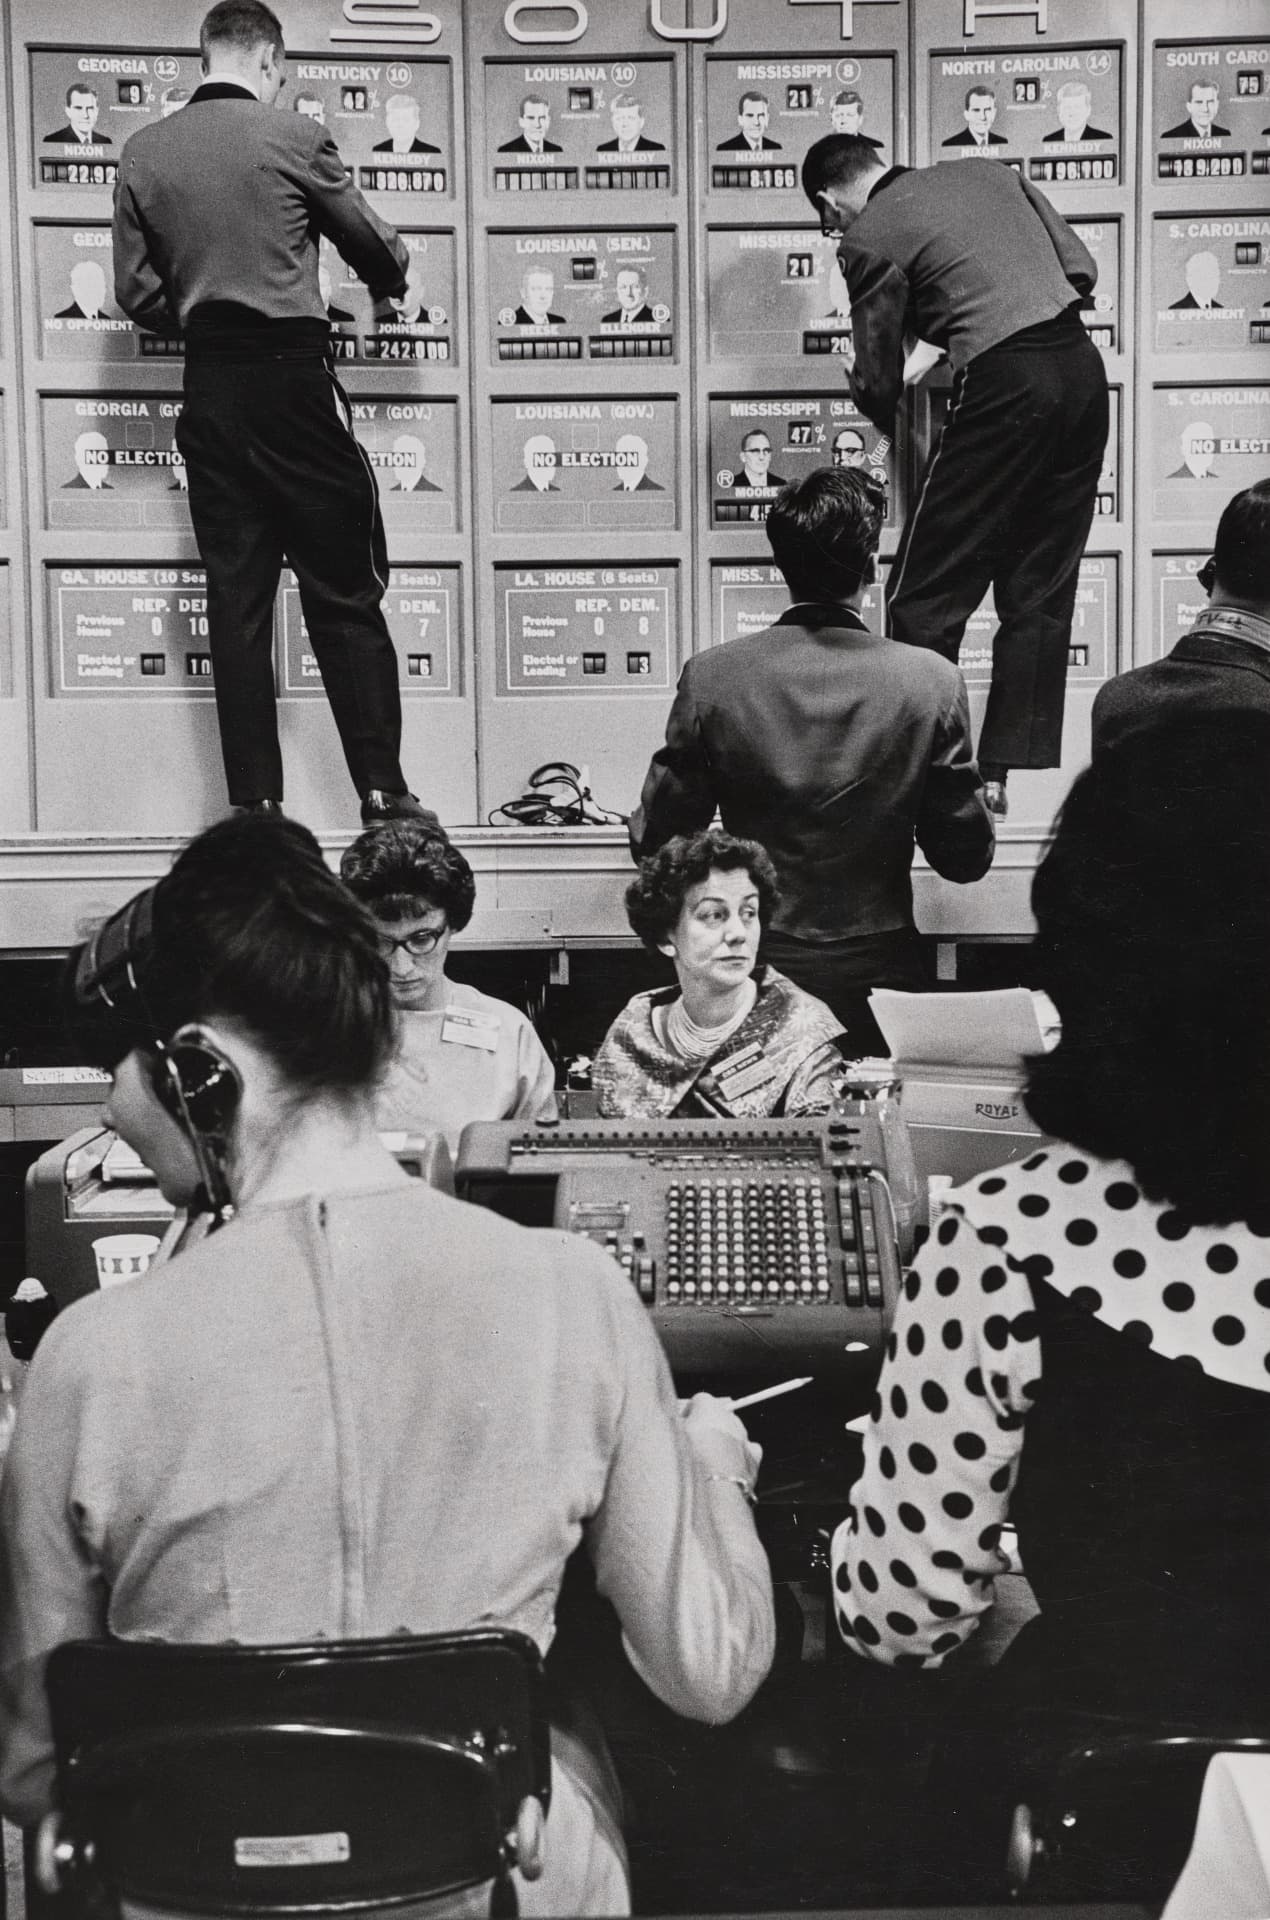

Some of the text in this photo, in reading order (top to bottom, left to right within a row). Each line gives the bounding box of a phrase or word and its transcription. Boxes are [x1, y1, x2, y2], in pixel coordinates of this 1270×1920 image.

[78, 58, 177, 75] GEORGIA 12
[942, 55, 1109, 76] NORTH CAROLINA 14
[1166, 51, 1220, 67] SOUTH
[297, 65, 409, 82] KENTUCKY 10
[525, 67, 632, 82] LOUISIANA 10
[737, 65, 854, 80] MISSISSIPPI 8
[64, 145, 104, 157] NIXON
[961, 145, 1000, 158] NIXON
[1043, 142, 1103, 154] KENNEDY
[1183, 138, 1222, 150] NIXON
[373, 153, 432, 166] KENNEDY
[517, 153, 556, 165] NIXON
[598, 152, 657, 165] KENNEDY
[735, 150, 773, 163] NIXON
[1169, 224, 1185, 239] S.
[515, 236, 651, 254] LOUISIANA (SEN.)
[1156, 310, 1175, 321] NO
[1178, 308, 1246, 321] OPPONENT
[44, 319, 135, 332] NO OPPONENT
[378, 322, 435, 334] JOHNSON
[1168, 392, 1184, 406] S.
[75, 402, 149, 417] GEORGIA
[386, 404, 432, 421] (GOV.)
[515, 404, 654, 420] LOUISIANA (GOV.)
[730, 401, 821, 417] MISSISSIPPI
[1191, 439, 1215, 454] NO
[86, 450, 186, 466] NO ELECTIO
[533, 452, 639, 467] NO ELECTION
[735, 487, 779, 498] MOORE
[1165, 559, 1182, 574] S.
[60, 569, 89, 585] GA.
[94, 570, 149, 584] HOUSE
[154, 570, 178, 585] (10
[514, 572, 540, 586] LA.
[544, 571, 596, 586] HOUSE
[722, 567, 764, 582] MISS.
[132, 598, 171, 613] REP.
[399, 599, 441, 614] DEM.
[575, 598, 660, 613] REP. DEM.
[76, 614, 126, 627] Previous
[151, 616, 163, 636] 0
[189, 616, 209, 636] 10
[418, 618, 430, 638] 7
[522, 615, 569, 627] Previous
[593, 616, 605, 636] 0
[638, 616, 650, 636] 8
[76, 626, 112, 638] House
[522, 626, 556, 638] House
[77, 653, 122, 666] Elected
[522, 654, 564, 666] Elected
[975, 1103, 1019, 1120] ROYAL
